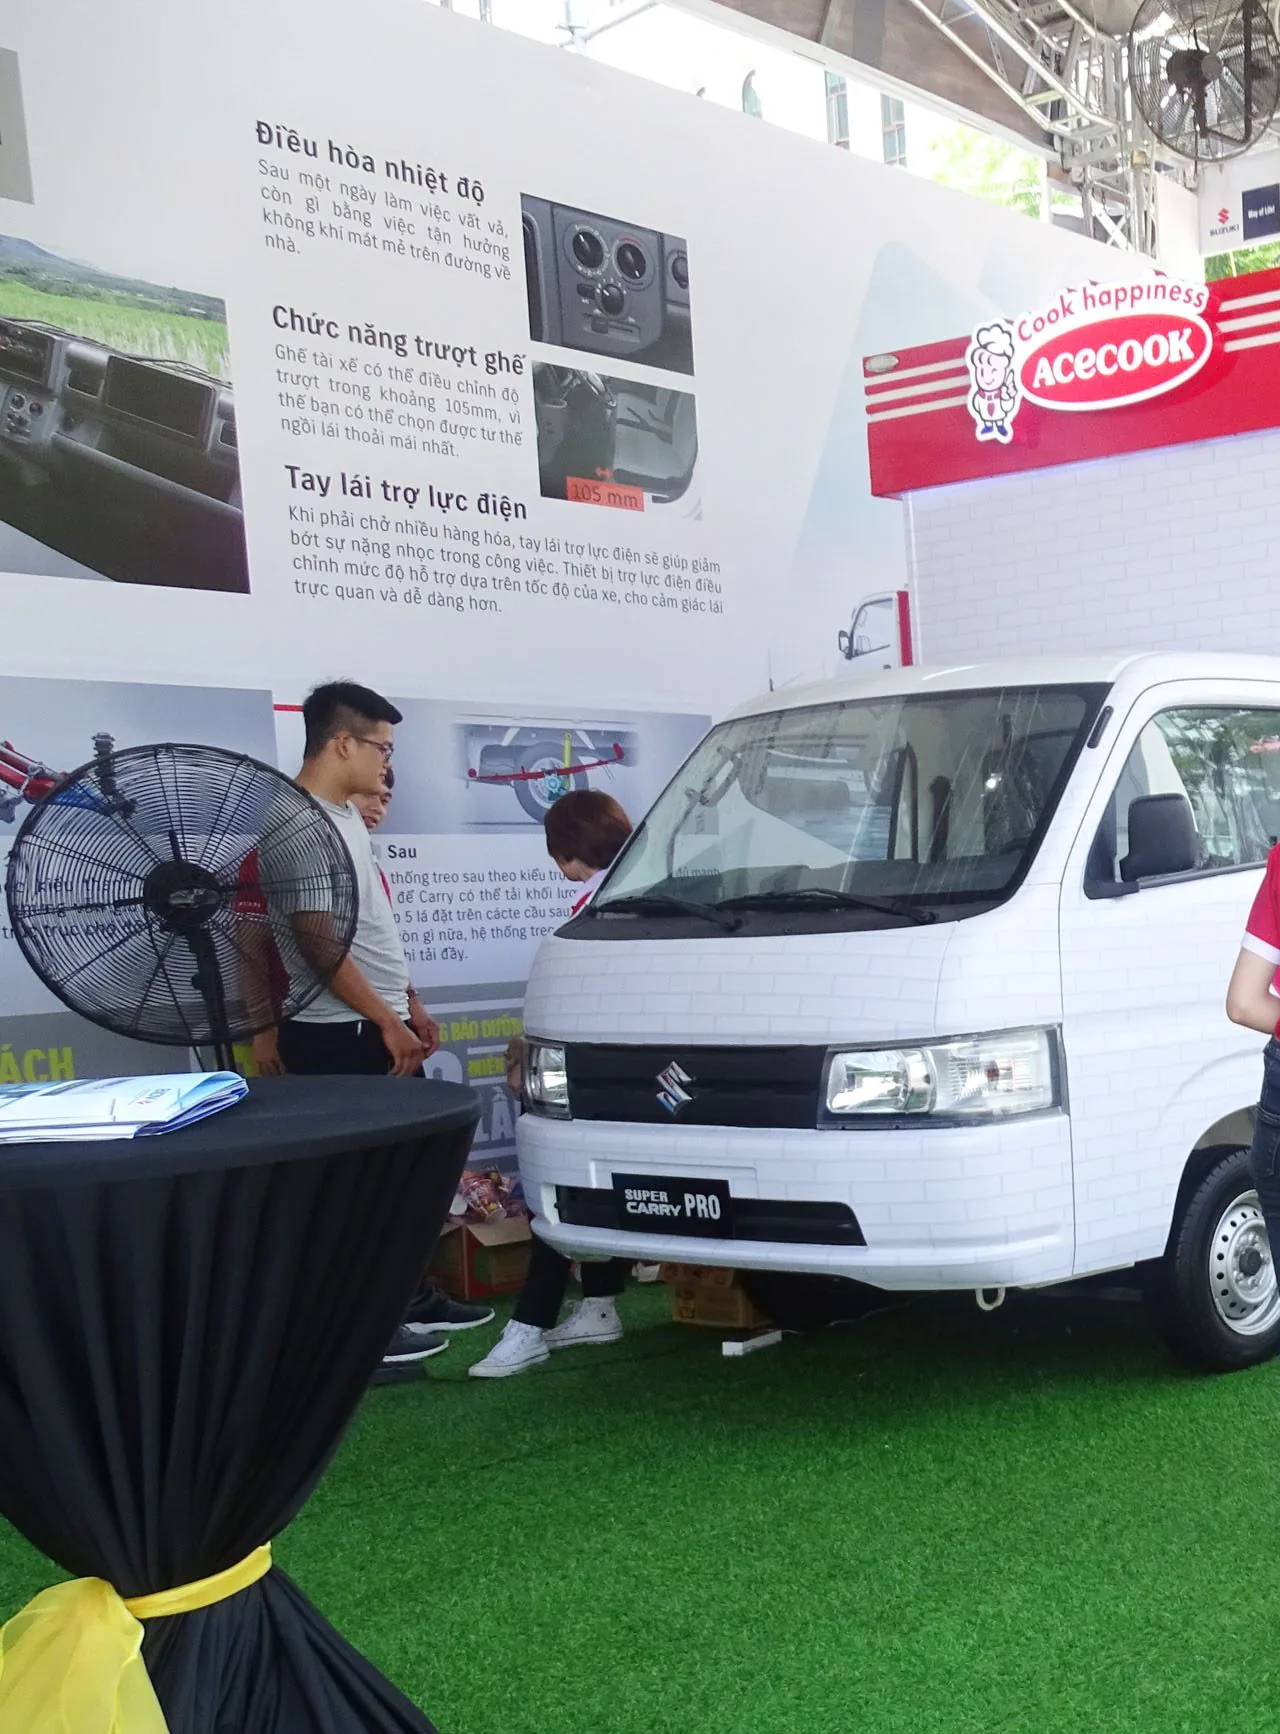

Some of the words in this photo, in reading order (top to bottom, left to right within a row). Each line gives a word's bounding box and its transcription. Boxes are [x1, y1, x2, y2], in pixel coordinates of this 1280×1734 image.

[255, 120, 318, 159] Điều
[328, 139, 376, 174] hòa
[385, 159, 449, 195] nhiệt
[457, 176, 484, 207] độ
[258, 158, 289, 181] Sau
[298, 172, 332, 193] một
[339, 183, 377, 206] ngày
[384, 191, 412, 213] làm
[419, 202, 451, 223] việc
[260, 185, 292, 205] còn
[305, 195, 320, 214] gì
[383, 216, 416, 236] việc
[427, 226, 451, 245] tận
[463, 233, 510, 262] hưởng
[262, 207, 315, 238] không
[348, 231, 379, 249] mát
[410, 244, 440, 264] trên
[444, 252, 492, 279] đường
[494, 263, 511, 281] về
[264, 233, 301, 254] nhà.
[1017, 295, 1075, 342] Cook
[1082, 283, 1205, 311] happiness
[272, 305, 340, 339] Chức
[348, 322, 408, 358] năng
[414, 335, 478, 368] trượt
[484, 350, 527, 376] ghế
[275, 343, 308, 364] Ghế
[312, 351, 333, 369] tài
[363, 362, 382, 378] có
[501, 387, 519, 406] độ
[276, 368, 320, 391] trượt
[328, 377, 371, 402] trong
[379, 385, 436, 413] khoảng
[445, 398, 502, 424] 105mm,
[508, 409, 521, 425] vì
[281, 416, 316, 436] ngồi
[321, 421, 339, 438] lái
[344, 426, 384, 446] thoải
[389, 435, 417, 451] mái
[310, 396, 340, 417] bạn
[344, 404, 364, 420] có
[398, 412, 435, 433] chọn
[439, 419, 477, 440] được
[480, 427, 496, 441] tư
[284, 464, 331, 498] Tay
[340, 472, 372, 499] lái
[380, 480, 420, 510] trợ
[428, 484, 468, 514] lực
[477, 492, 527, 522] điện
[573, 484, 602, 503] 105
[607, 491, 639, 509] mm
[288, 504, 314, 523] Khi
[320, 510, 354, 528] phải
[360, 514, 391, 532] chở
[395, 519, 438, 538] nhiều
[443, 524, 480, 547] hàng
[519, 535, 541, 553] tay
[544, 537, 561, 553] lái
[564, 540, 585, 559] trợ
[588, 543, 609, 561] lực
[613, 546, 641, 564] điện
[290, 529, 320, 548] bớt
[325, 536, 346, 554] sự
[396, 542, 435, 562] nhọc
[440, 547, 481, 569] trong
[485, 553, 522, 574] công
[525, 557, 559, 576] việc.
[601, 565, 613, 584] bị
[617, 569, 637, 586] trợ
[640, 570, 660, 588] lực
[664, 574, 691, 592] điện
[293, 579, 329, 599] trực
[335, 585, 375, 601] quan
[379, 586, 398, 602] và
[427, 591, 465, 612] dàng
[469, 594, 502, 613] hơn.
[385, 564, 405, 583] độ
[433, 570, 456, 588] trợ
[460, 572, 488, 591] dựa
[491, 576, 521, 592] trên
[525, 579, 548, 595] tốc
[552, 582, 570, 600] độ
[574, 583, 598, 600] của
[624, 590, 648, 605] cho
[387, 844, 417, 859] Sau
[390, 870, 430, 887] thống
[432, 872, 459, 884] treo
[462, 872, 485, 883] sau
[488, 869, 517, 883] theo
[397, 889, 415, 904] để
[419, 890, 454, 905] Carry
[459, 889, 475, 902] có
[505, 886, 521, 901] tải
[405, 910, 413, 923] 5
[416, 909, 428, 923] lá
[456, 908, 482, 921] trên
[486, 907, 521, 920] cácte
[524, 905, 546, 919] cầu
[549, 907, 569, 918] sau
[419, 947, 436, 961] tải
[423, 928, 434, 945] gì
[471, 926, 487, 942] hệ
[490, 925, 527, 940] thống
[624, 1188, 668, 1203] SUPER
[626, 1201, 682, 1217] CARRY
[684, 1193, 721, 1220] PRO
